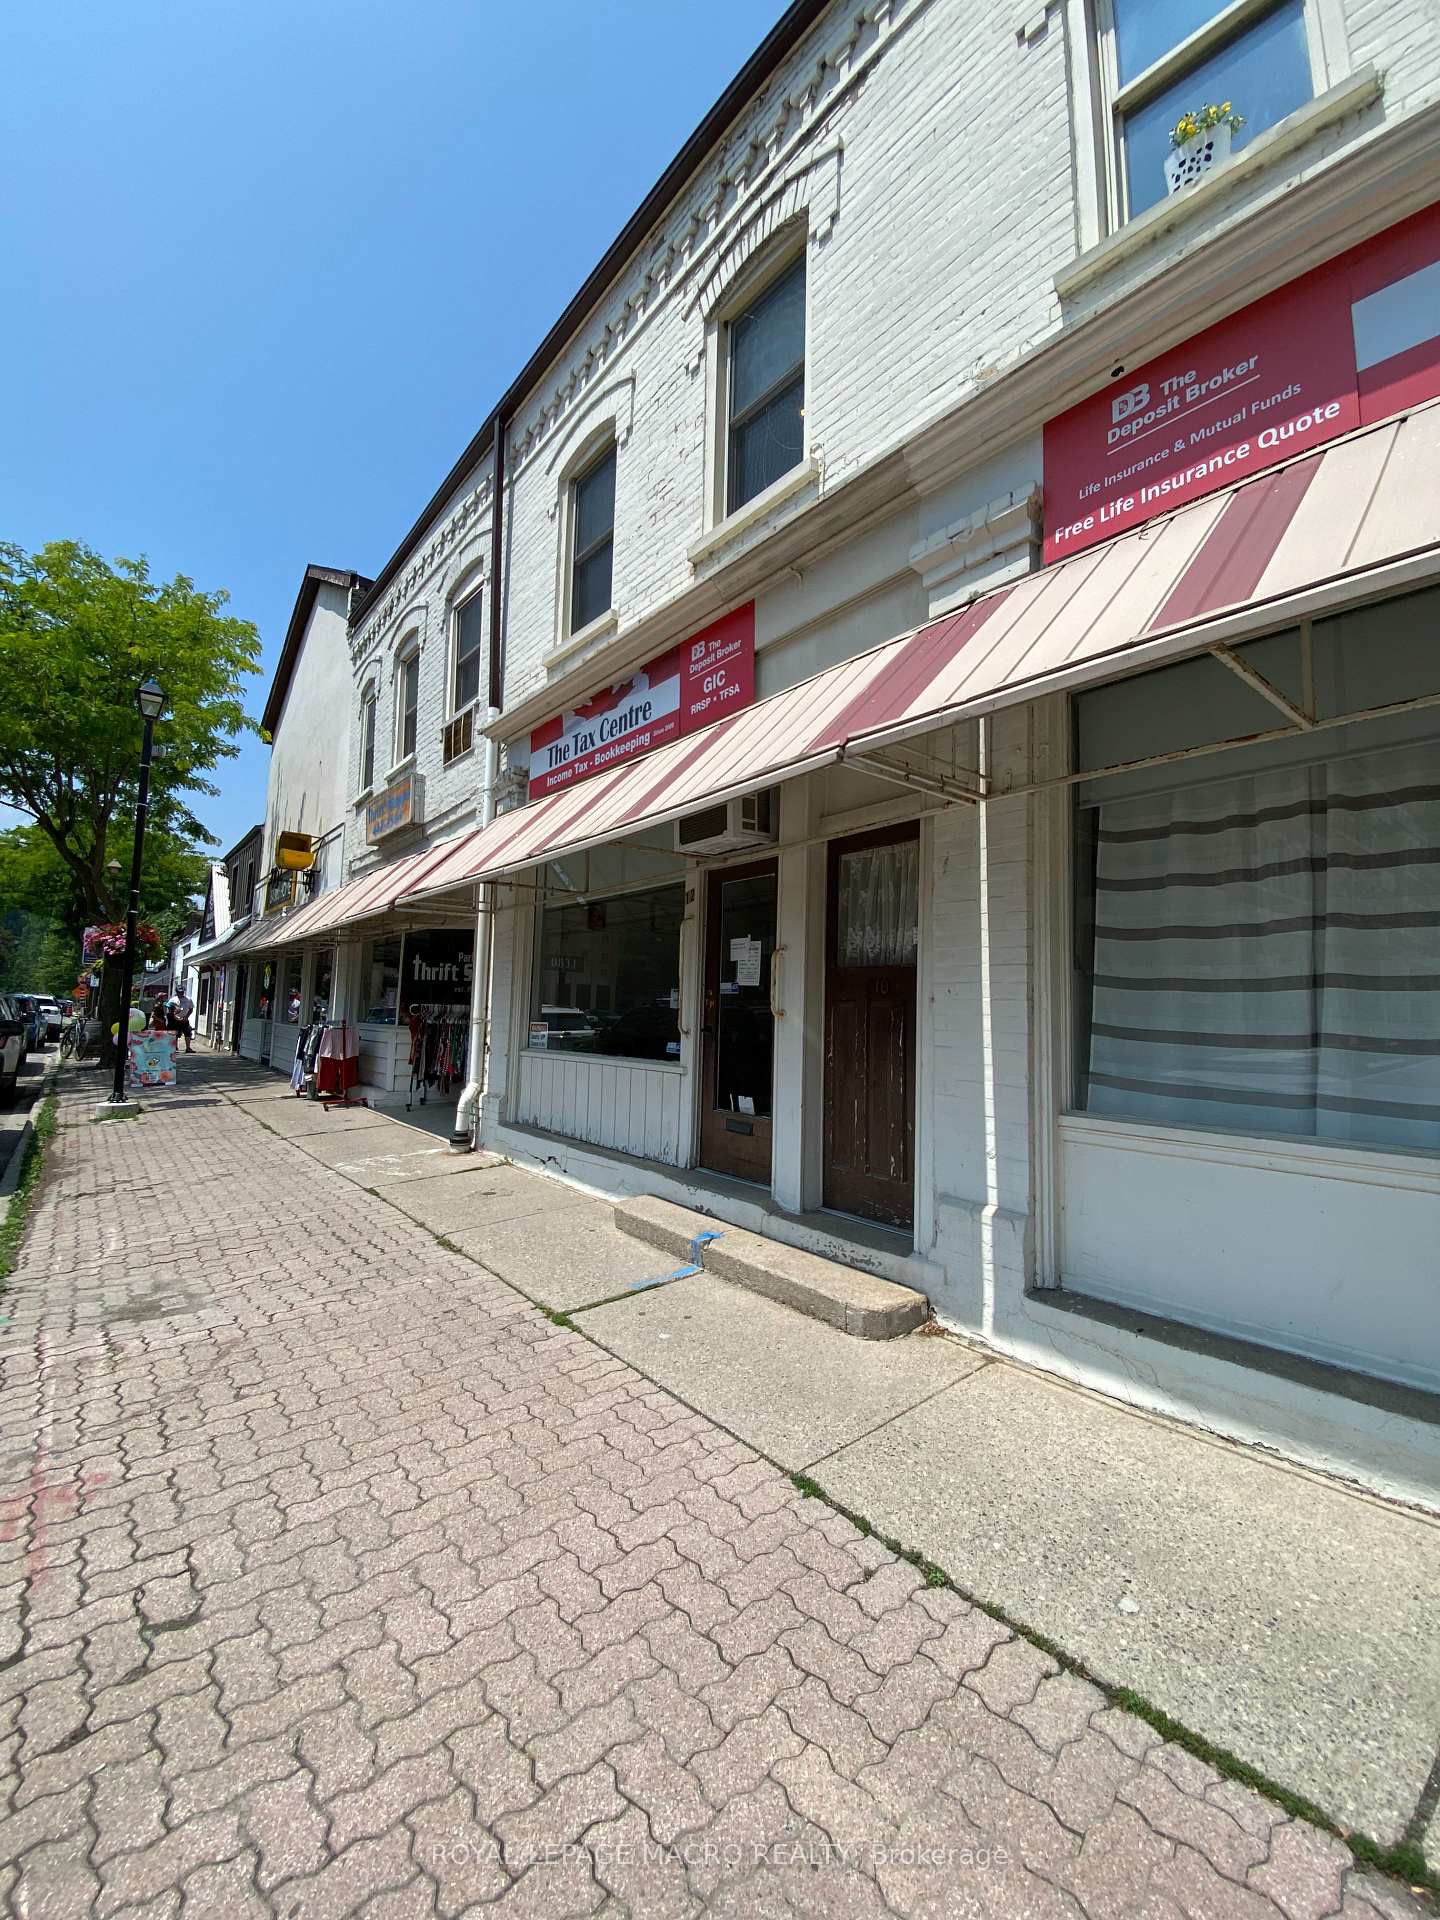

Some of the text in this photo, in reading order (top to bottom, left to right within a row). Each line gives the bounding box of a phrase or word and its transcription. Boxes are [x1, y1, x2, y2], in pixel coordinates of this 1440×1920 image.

[1107, 354, 1259, 445] Deposit Broker
[1160, 369, 1196, 397] The
[1079, 382, 1302, 500] Life Insurance & Mutual Funds
[1054, 402, 1341, 544] Free Life Insurance Quote
[689, 640, 742, 674] Deposit Broker
[708, 640, 721, 652] The
[690, 683, 740, 715] RRSP TFSA
[703, 670, 726, 693] GIC
[547, 700, 652, 768] The Tax Centre
[546, 731, 650, 787] Income Tax Bookkeeping
